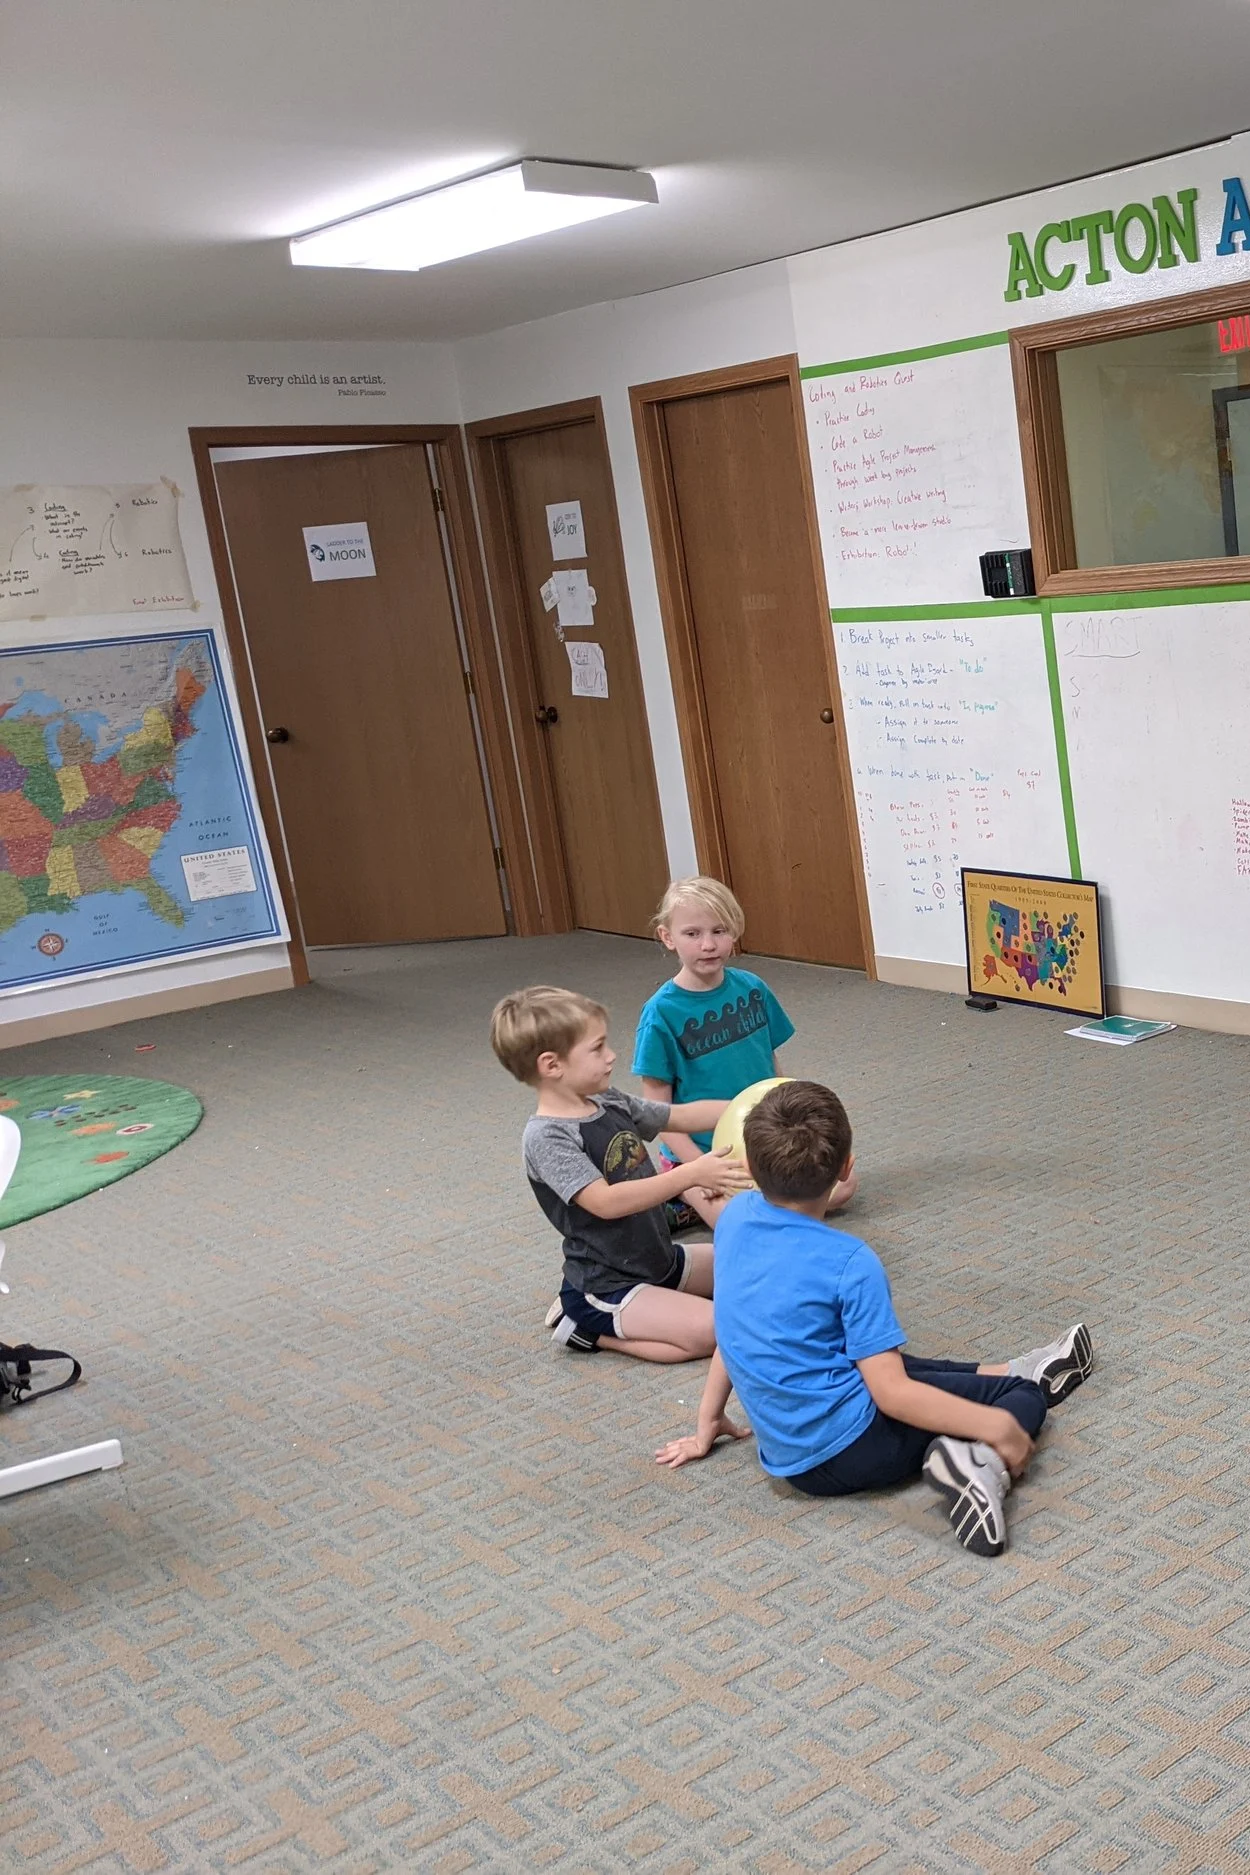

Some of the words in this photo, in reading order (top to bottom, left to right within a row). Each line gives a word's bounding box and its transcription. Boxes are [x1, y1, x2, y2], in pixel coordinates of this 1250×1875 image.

[1004, 188, 1200, 302] ACTON
[247, 374, 284, 386] Every
[288, 374, 316, 384] child
[320, 374, 329, 384] is
[333, 376, 347, 384] an
[351, 374, 385, 384] artist.
[809, 386, 836, 404] Coding
[844, 384, 856, 394] and
[894, 369, 915, 385] Quest
[864, 425, 883, 440] Robot
[27, 506, 35, 514] 3
[330, 549, 366, 561] MOON
[849, 628, 873, 645] Break
[855, 660, 869, 676] Add
[65, 692, 127, 703] CANADA
[189, 816, 231, 827] ATLANTIC
[199, 832, 229, 840] OCEAN
[184, 854, 214, 863] UNITED
[218, 849, 245, 857] STATES
[686, 1026, 731, 1056] ocean
[736, 1004, 766, 1037] child
